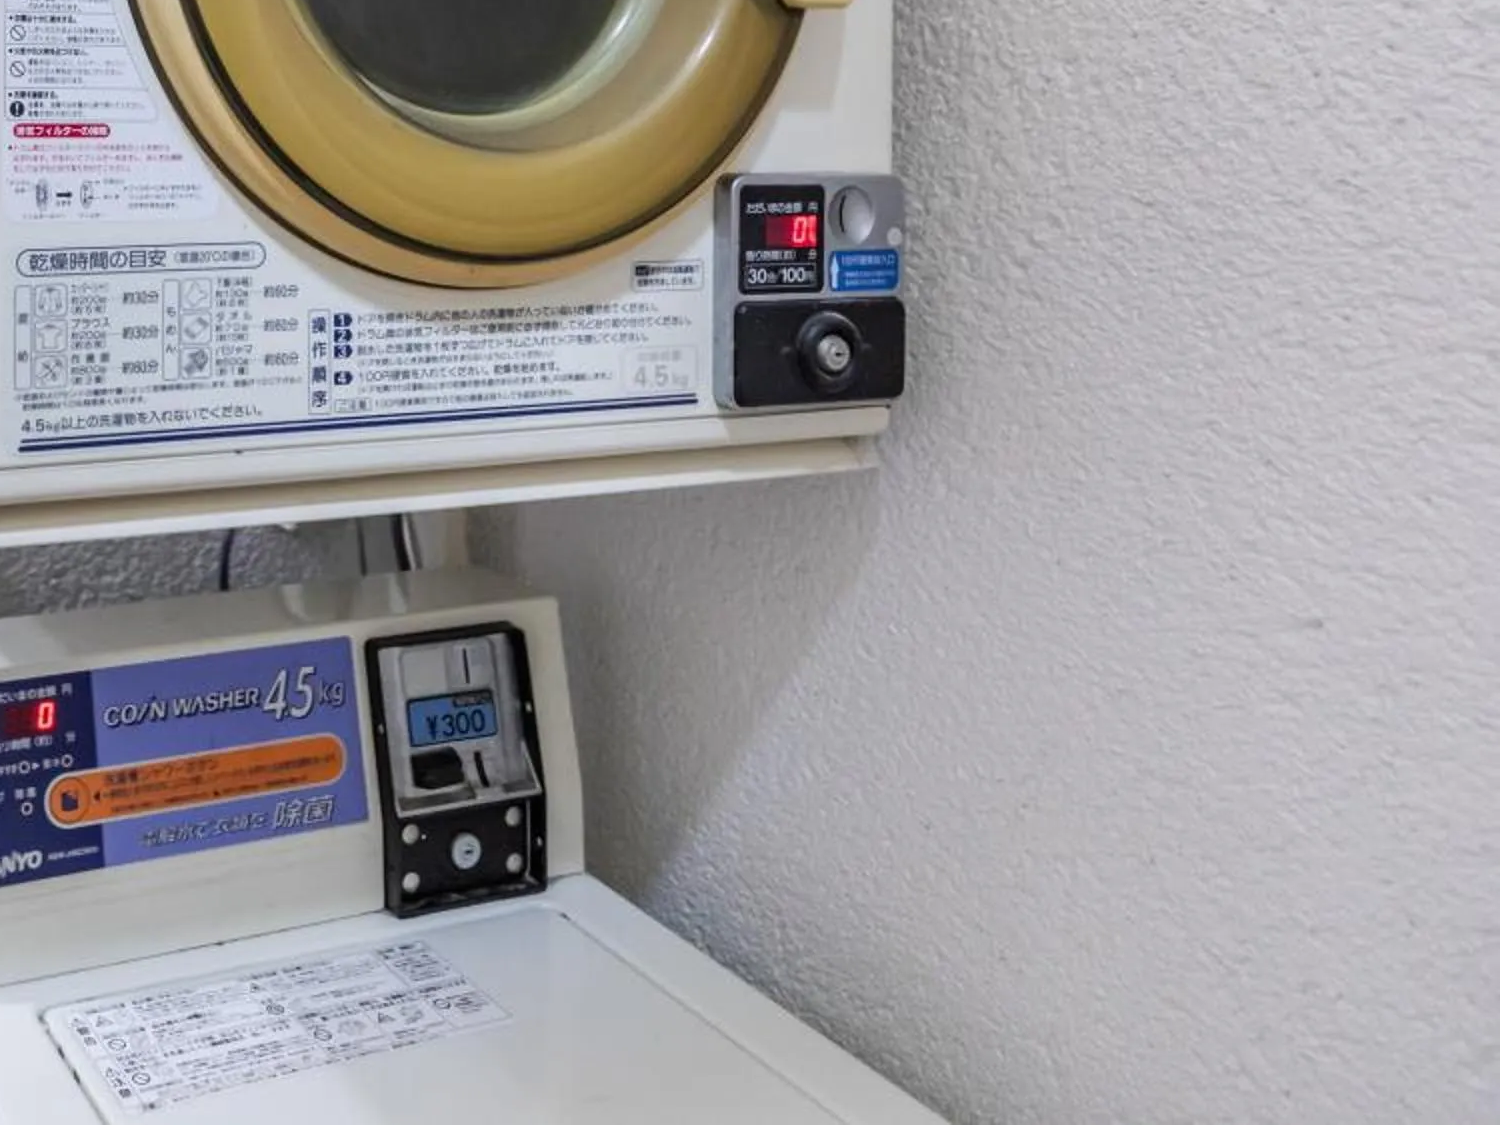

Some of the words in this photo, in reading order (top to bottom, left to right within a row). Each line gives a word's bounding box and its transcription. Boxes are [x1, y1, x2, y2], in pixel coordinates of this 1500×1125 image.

[29, 250, 167, 273] 乾燥時間の目安
[37, 701, 55, 730] 0
[172, 687, 261, 718] WASHER
[425, 707, 486, 740] ¥300
